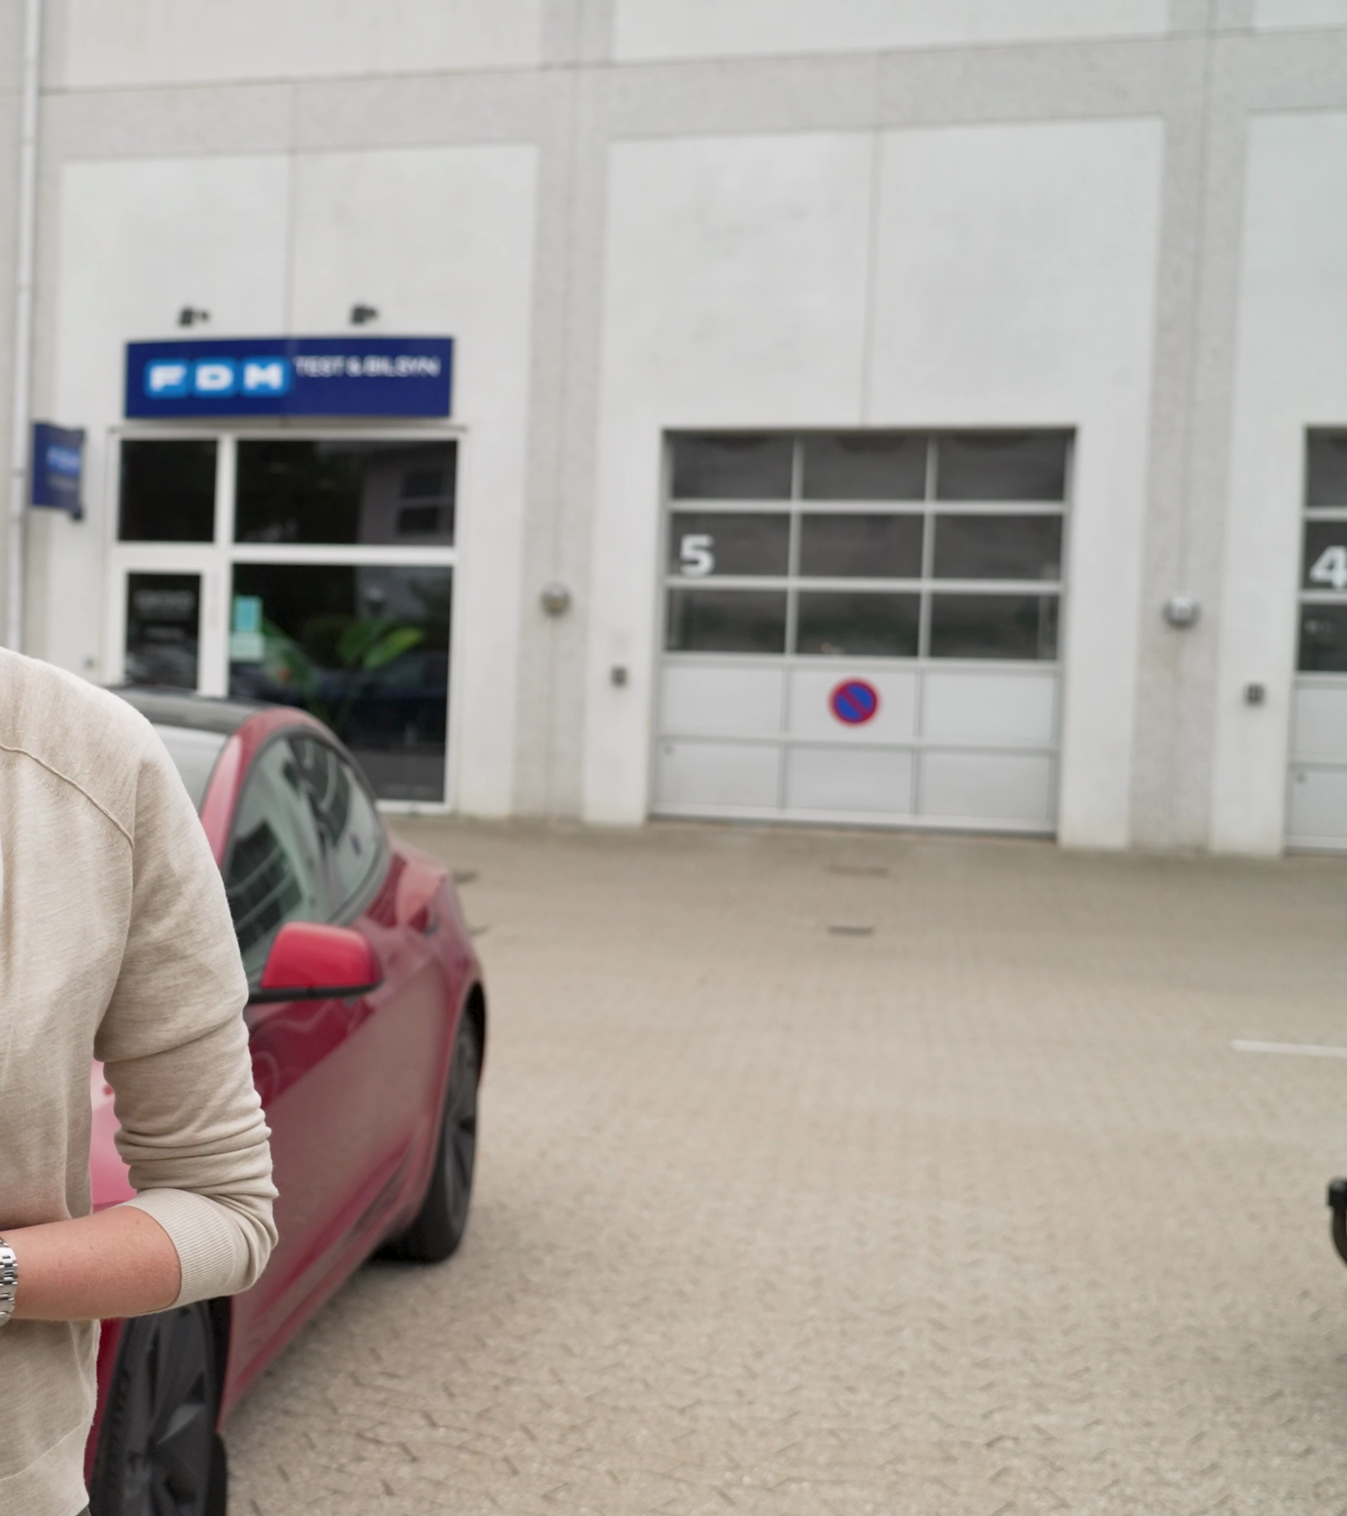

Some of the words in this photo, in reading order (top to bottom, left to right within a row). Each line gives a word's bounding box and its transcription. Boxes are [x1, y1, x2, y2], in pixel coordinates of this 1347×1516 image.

[150, 363, 284, 391] FDM
[292, 355, 346, 378] TEST
[680, 534, 714, 576] 5
[1309, 545, 1347, 589] 4
